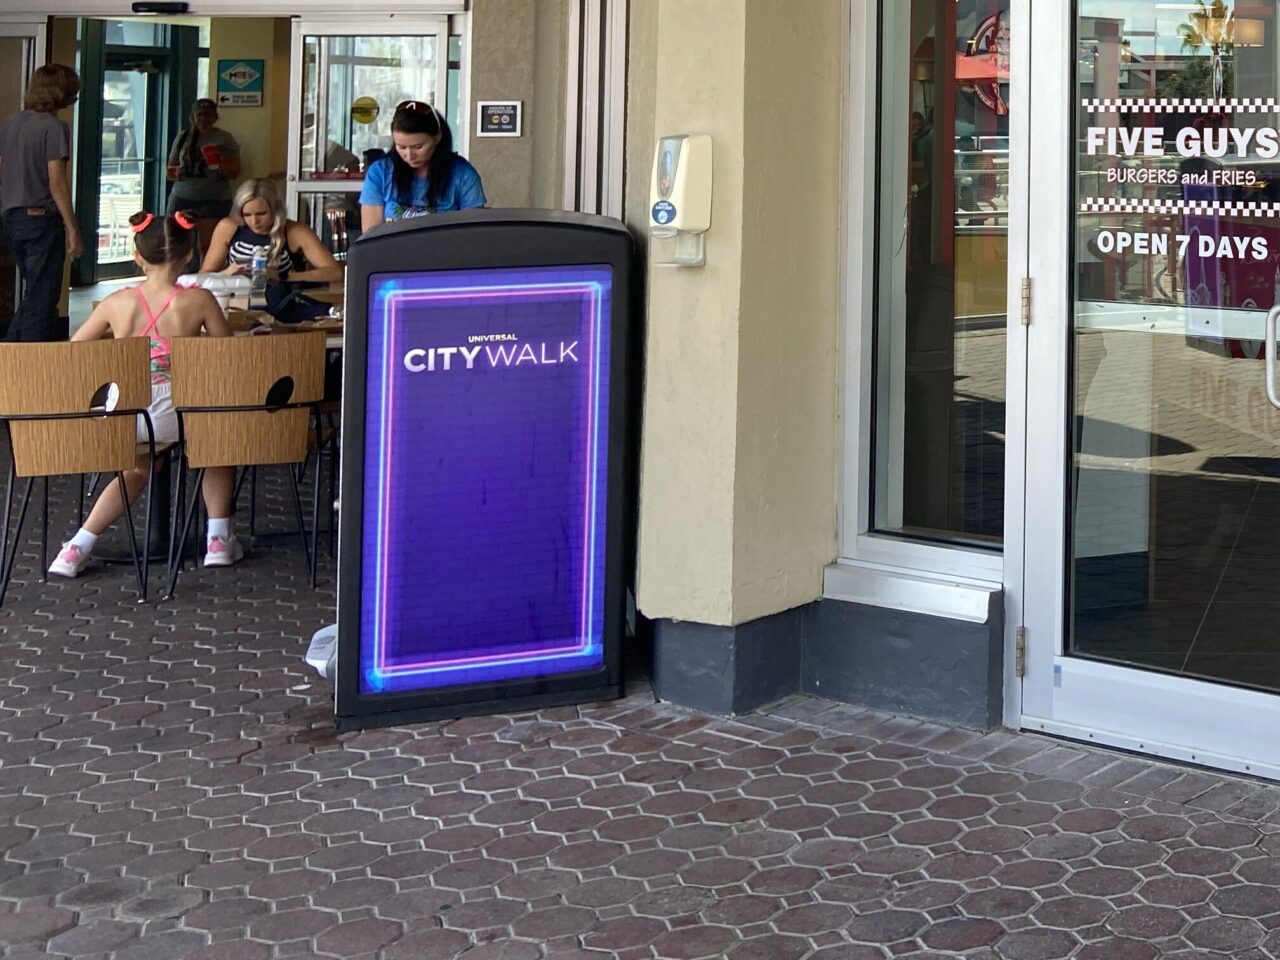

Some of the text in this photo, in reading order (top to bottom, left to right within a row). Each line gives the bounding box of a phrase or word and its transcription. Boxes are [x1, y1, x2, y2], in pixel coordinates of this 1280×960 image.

[1087, 126, 1279, 158] FIVE GUYS
[1107, 167, 1256, 186] BURGERS and FRIES
[1097, 230, 1268, 260] OPEN 7 DAYS
[467, 333, 518, 343] UNIVERSAL
